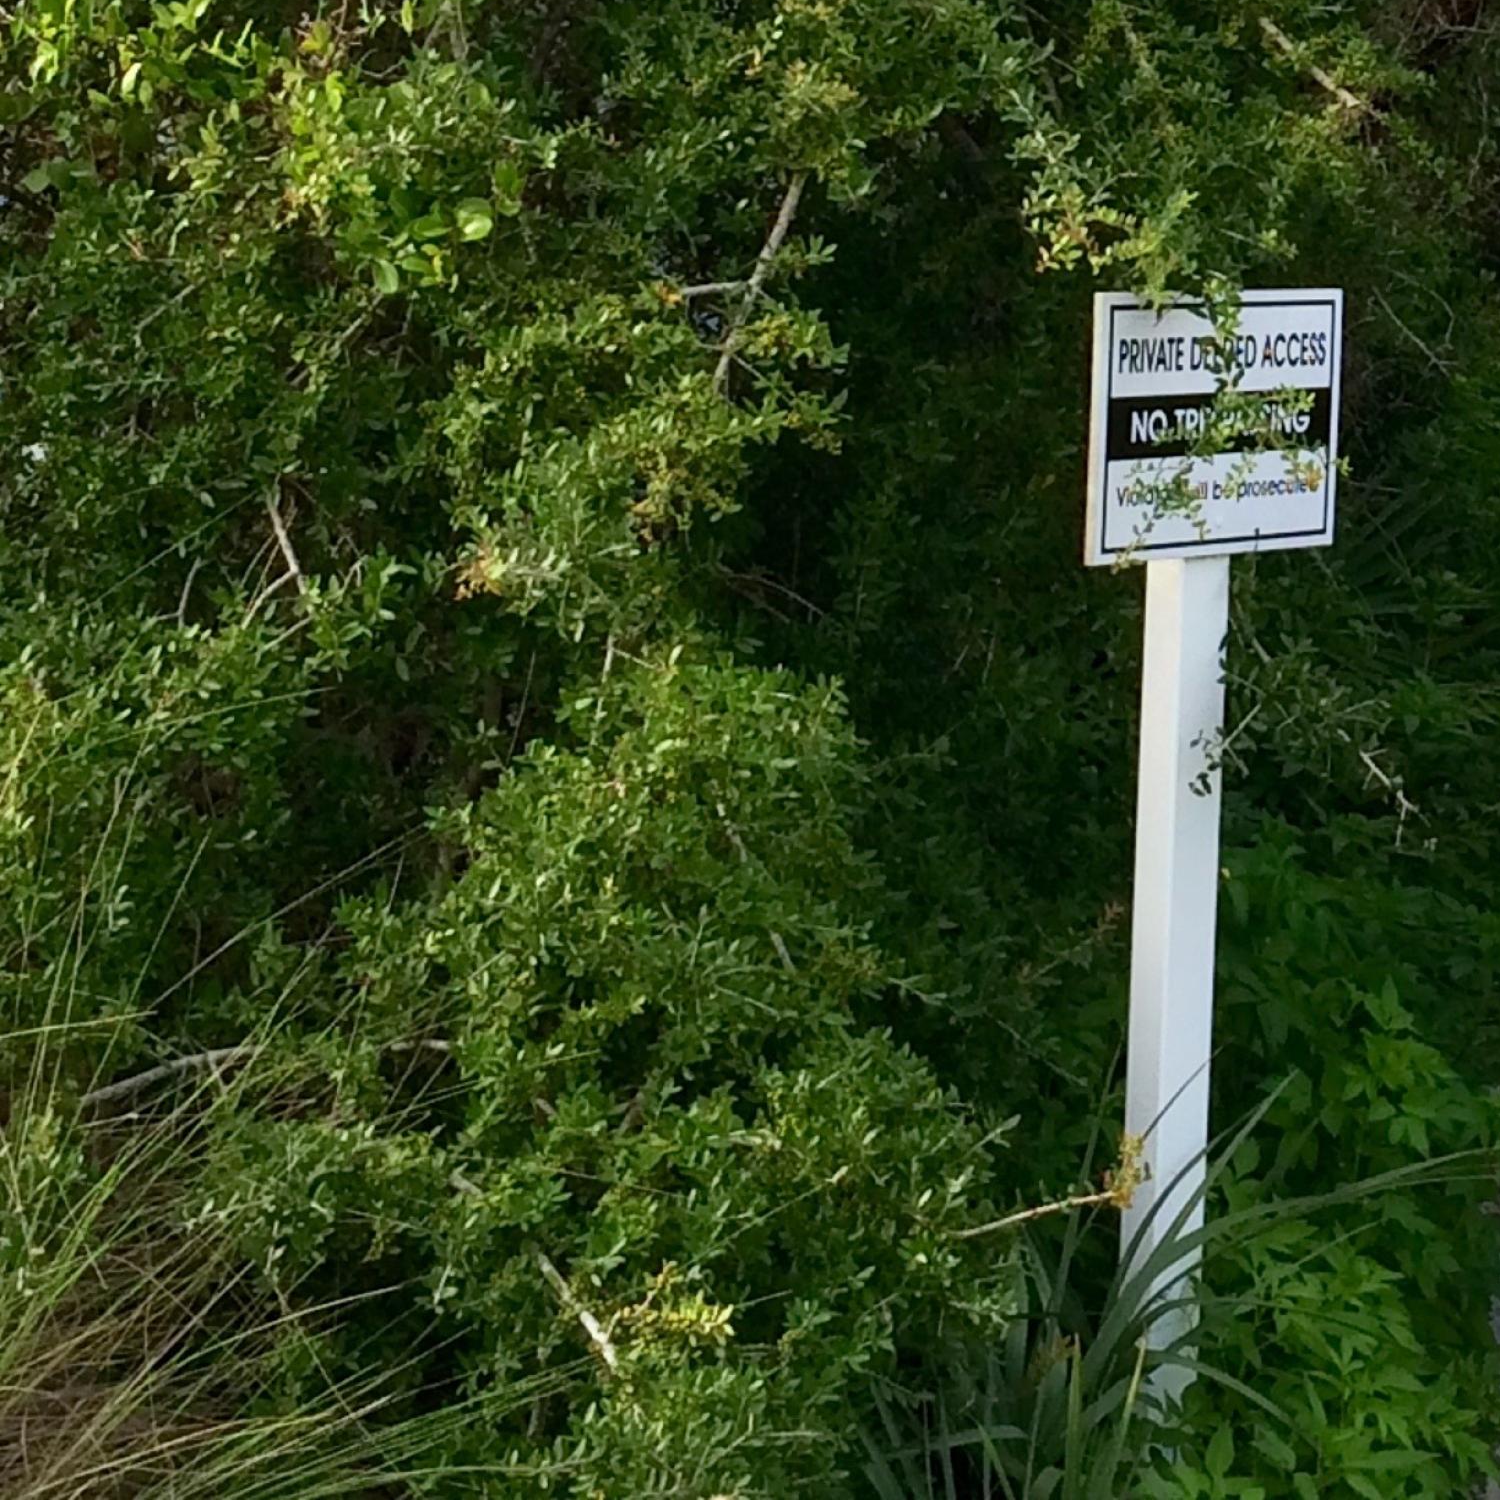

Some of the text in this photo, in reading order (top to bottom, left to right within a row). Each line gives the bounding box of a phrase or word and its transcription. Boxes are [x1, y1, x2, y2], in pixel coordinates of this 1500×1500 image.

[1118, 336, 1185, 373] PRIVATE
[1261, 331, 1327, 368] ACCESS
[1130, 409, 1168, 444] NO
